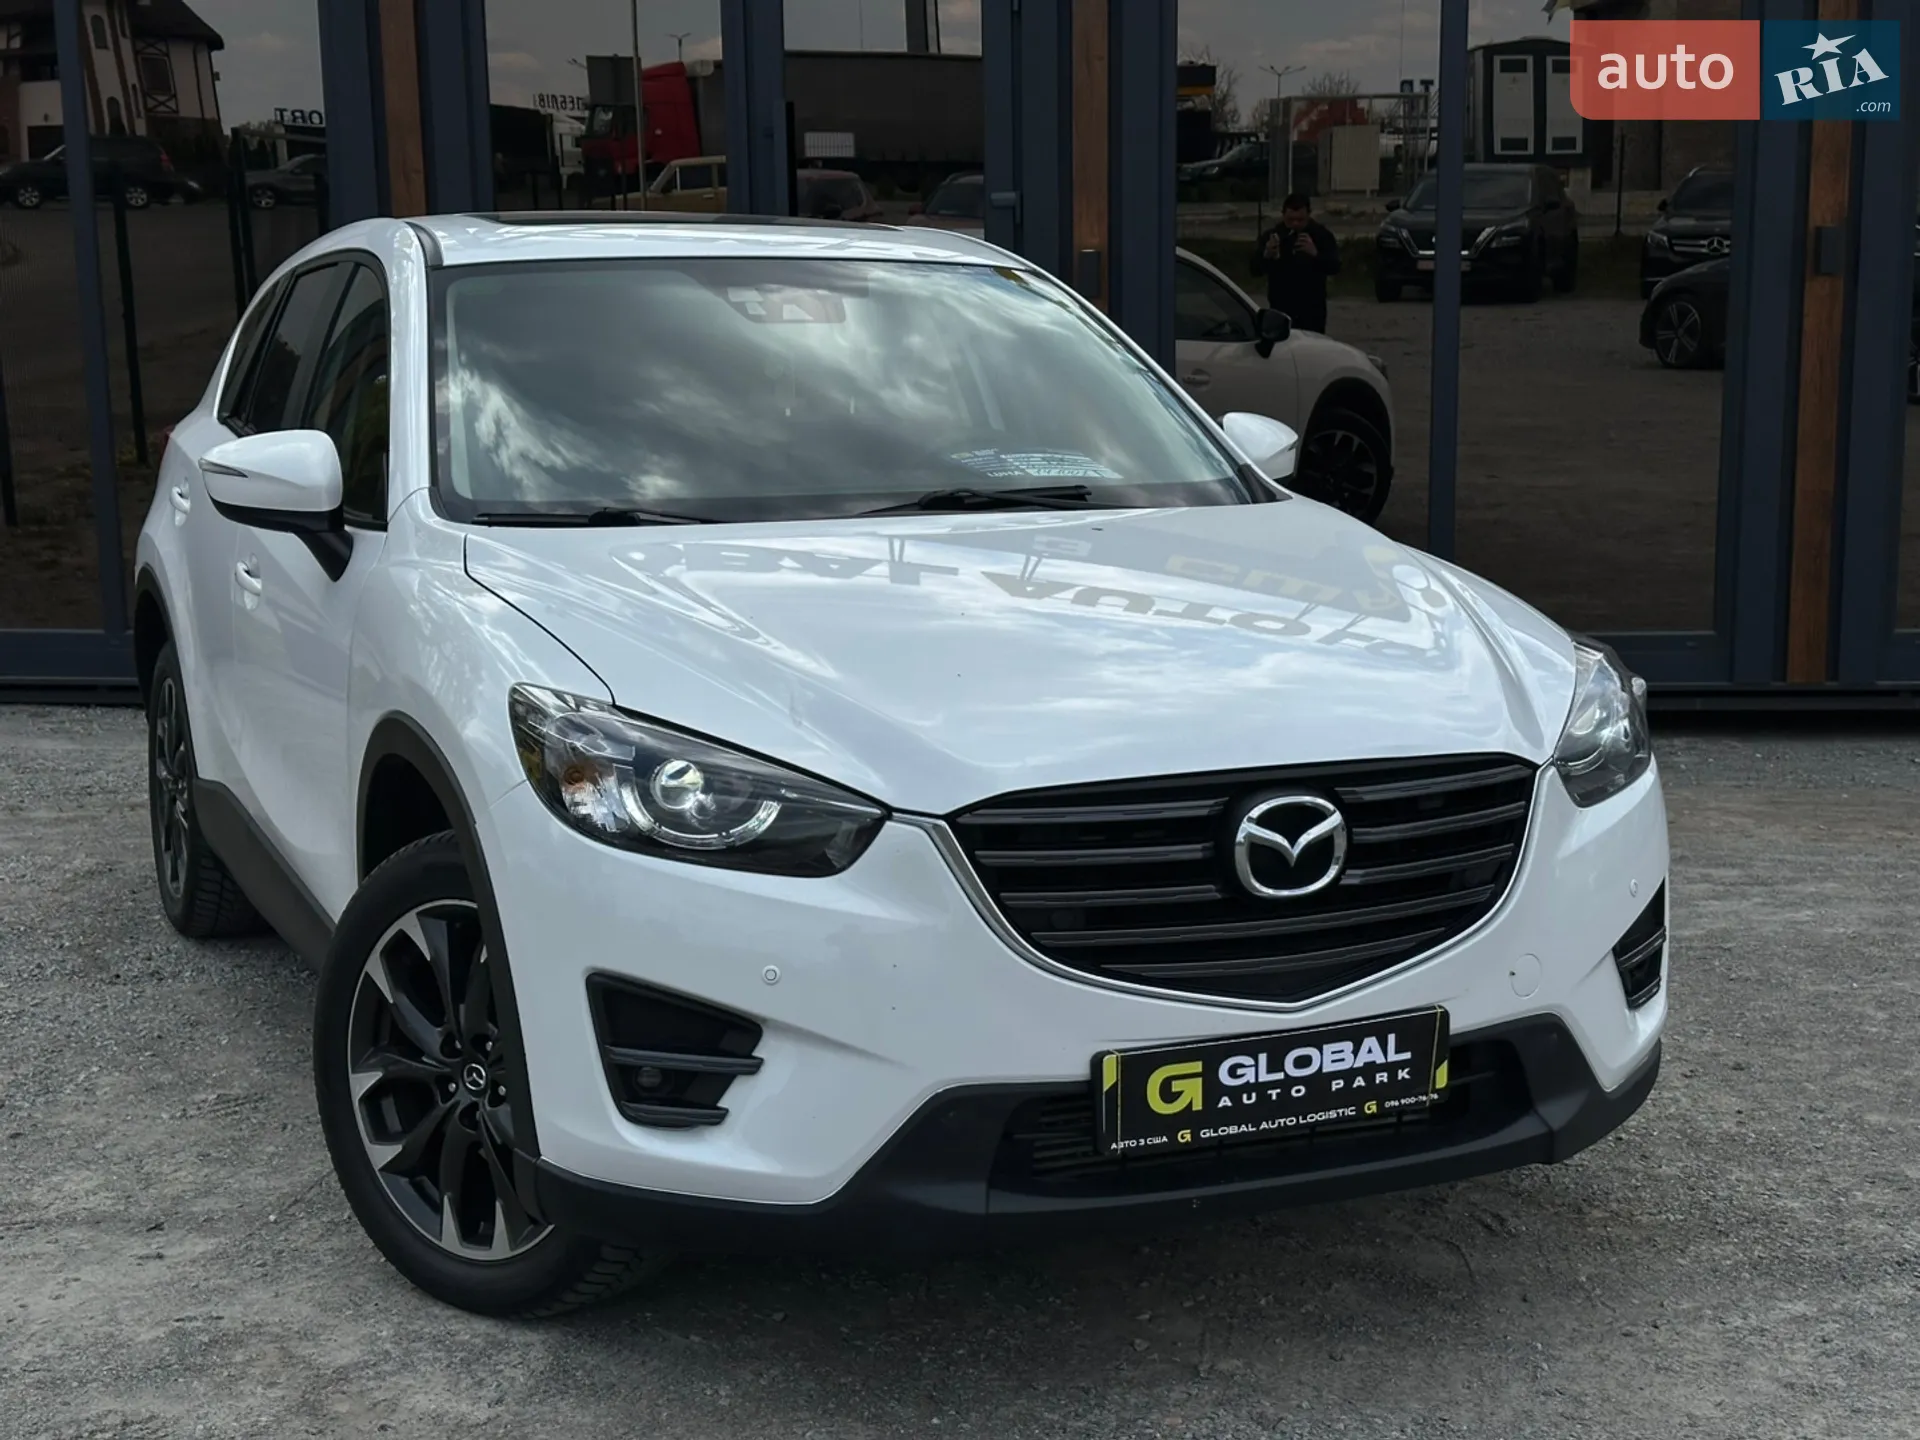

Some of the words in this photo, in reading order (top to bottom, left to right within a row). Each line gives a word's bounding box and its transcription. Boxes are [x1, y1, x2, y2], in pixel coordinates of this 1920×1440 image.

[1217, 1033, 1412, 1087] GLOBAL
[1217, 1085, 1306, 1108] AUTO
[1331, 1067, 1411, 1092] PARK
[1200, 1123, 1257, 1138] GLOBAL
[1259, 1116, 1297, 1130] AUTO
[1298, 1106, 1357, 1125] LOGISTIC
